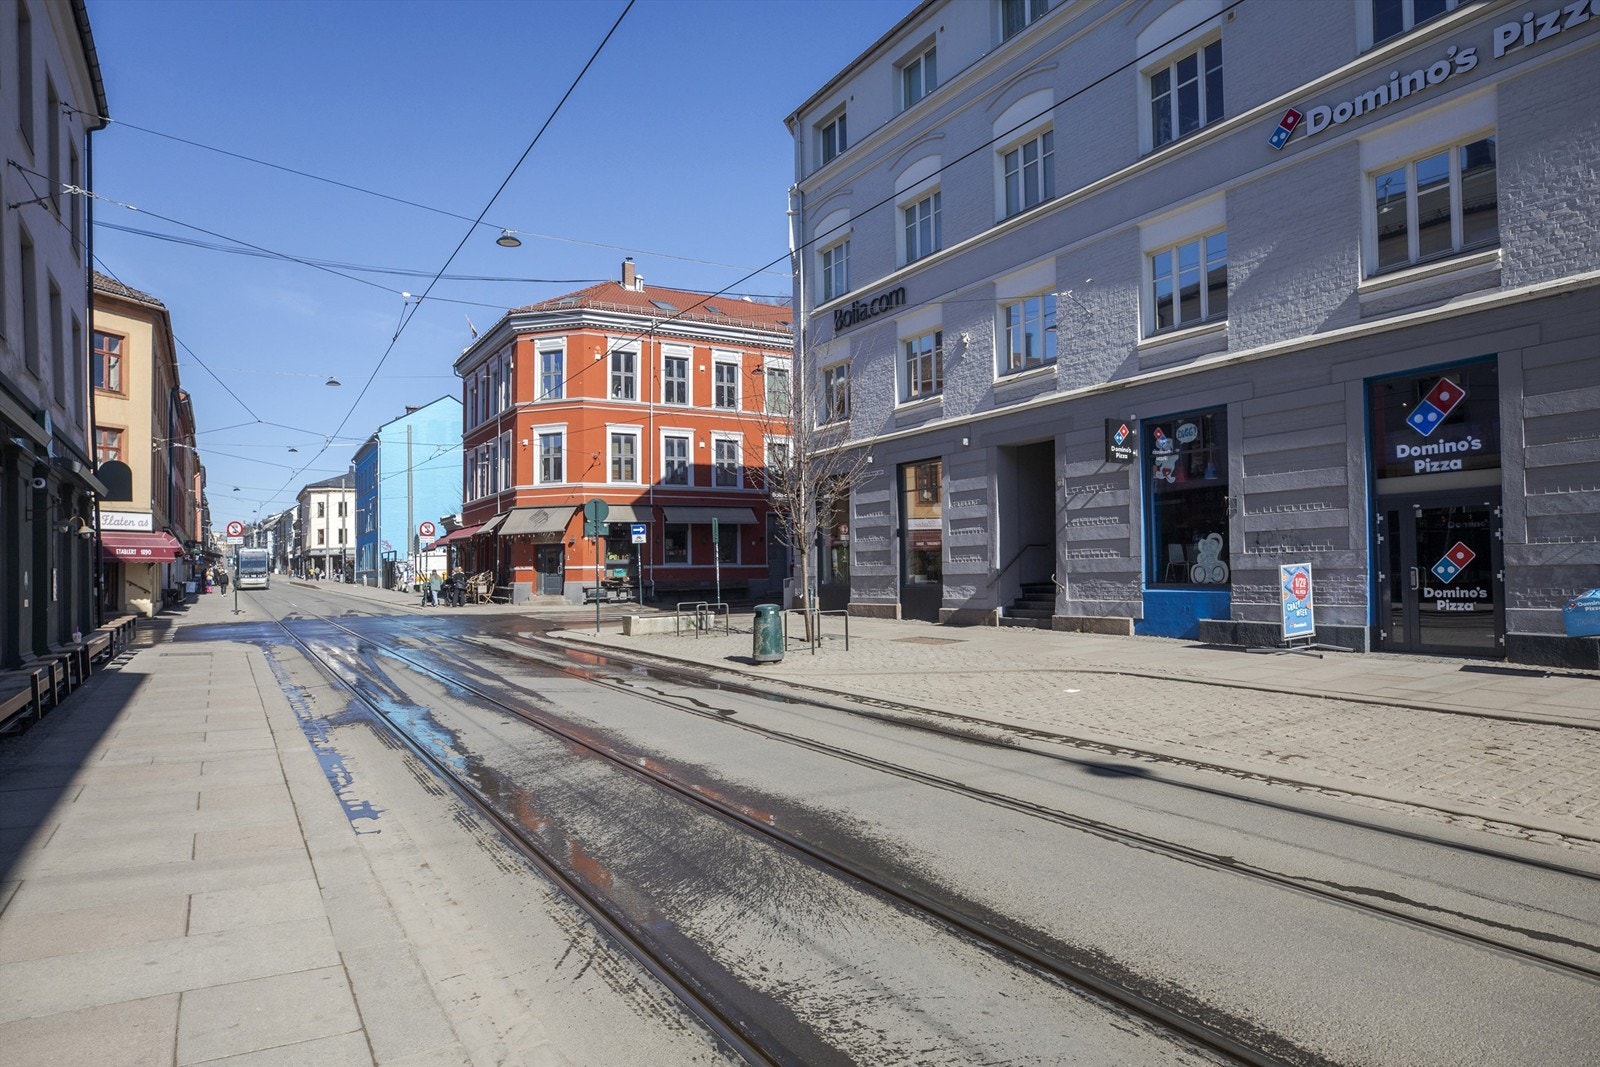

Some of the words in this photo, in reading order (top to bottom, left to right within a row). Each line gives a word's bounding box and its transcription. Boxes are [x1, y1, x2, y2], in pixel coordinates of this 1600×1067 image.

[1306, 45, 1478, 136] Domino's
[834, 287, 906, 331] Bolia.com
[1111, 445, 1132, 454] Domino's
[1396, 436, 1482, 458] Domino's
[1414, 458, 1462, 473] Pizza
[101, 514, 135, 527] Flaten
[137, 519, 149, 527] as
[1423, 587, 1487, 598] Domino's
[1437, 599, 1474, 611] Pizza
